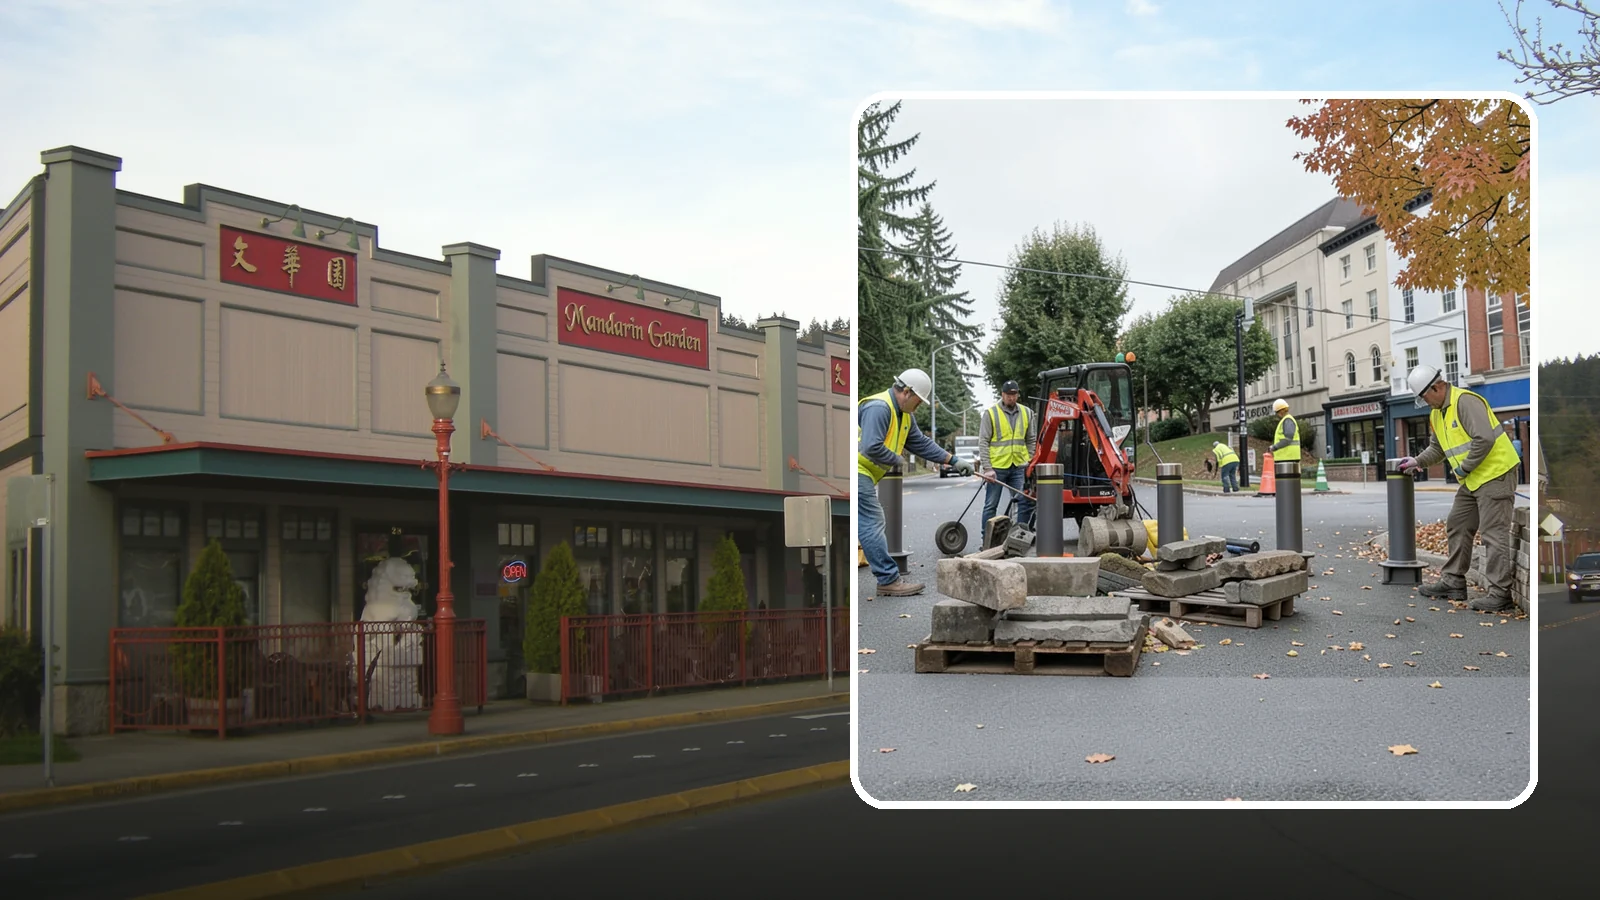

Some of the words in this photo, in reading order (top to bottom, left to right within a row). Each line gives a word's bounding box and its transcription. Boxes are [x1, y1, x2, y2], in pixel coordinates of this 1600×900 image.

[230, 235, 346, 291] 文華園
[564, 302, 644, 341] Mandarin
[647, 320, 702, 352] Garden
[503, 565, 527, 578] OPEN
